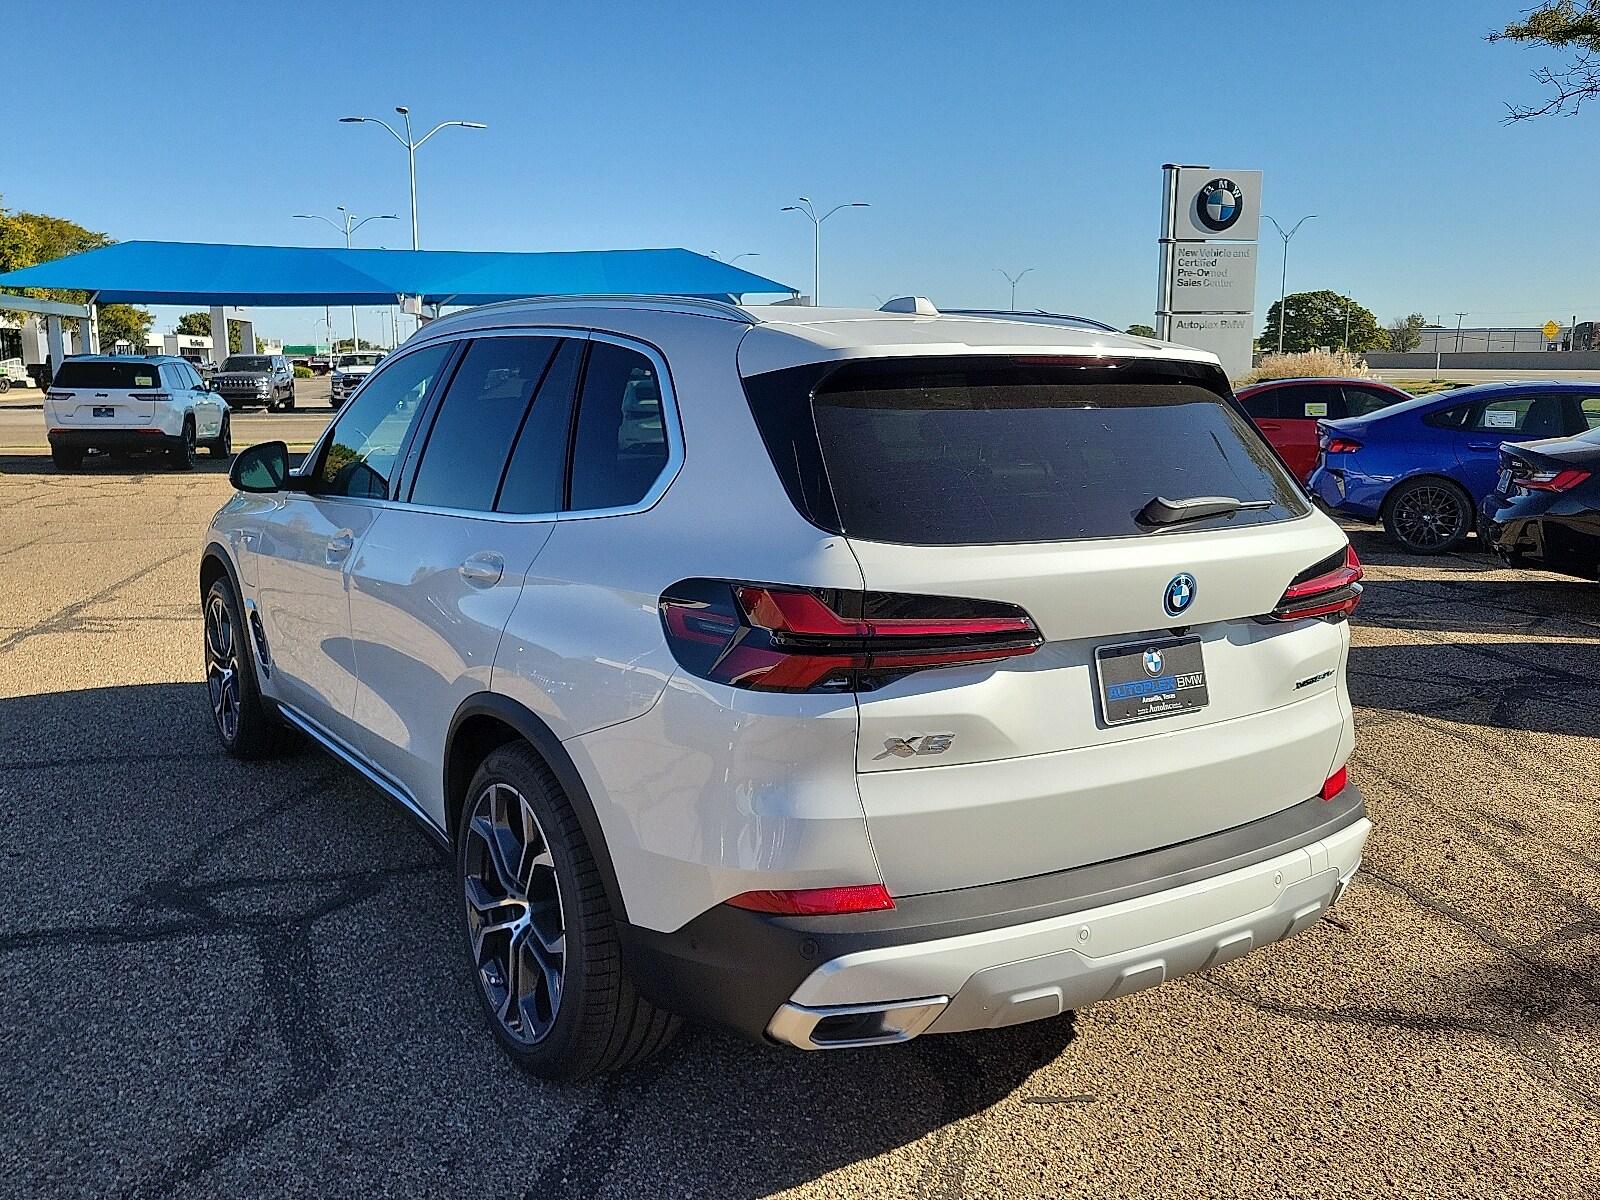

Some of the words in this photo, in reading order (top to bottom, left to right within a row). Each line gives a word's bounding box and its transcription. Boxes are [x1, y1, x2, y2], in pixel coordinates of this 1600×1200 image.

[1203, 179, 1242, 199] BMW
[1178, 248, 1199, 257] New
[1200, 248, 1231, 257] Vehicle
[1233, 248, 1250, 258] and
[1178, 258, 1217, 267] Certified
[1177, 268, 1228, 277] Pre-Owned
[1176, 278, 1202, 287] Sales
[1203, 278, 1234, 287] Center
[1176, 320, 1218, 330] Autoplex
[1220, 320, 1246, 329] BMW
[1109, 678, 1175, 699] AUTOPLEX
[1177, 674, 1203, 688] BMW
